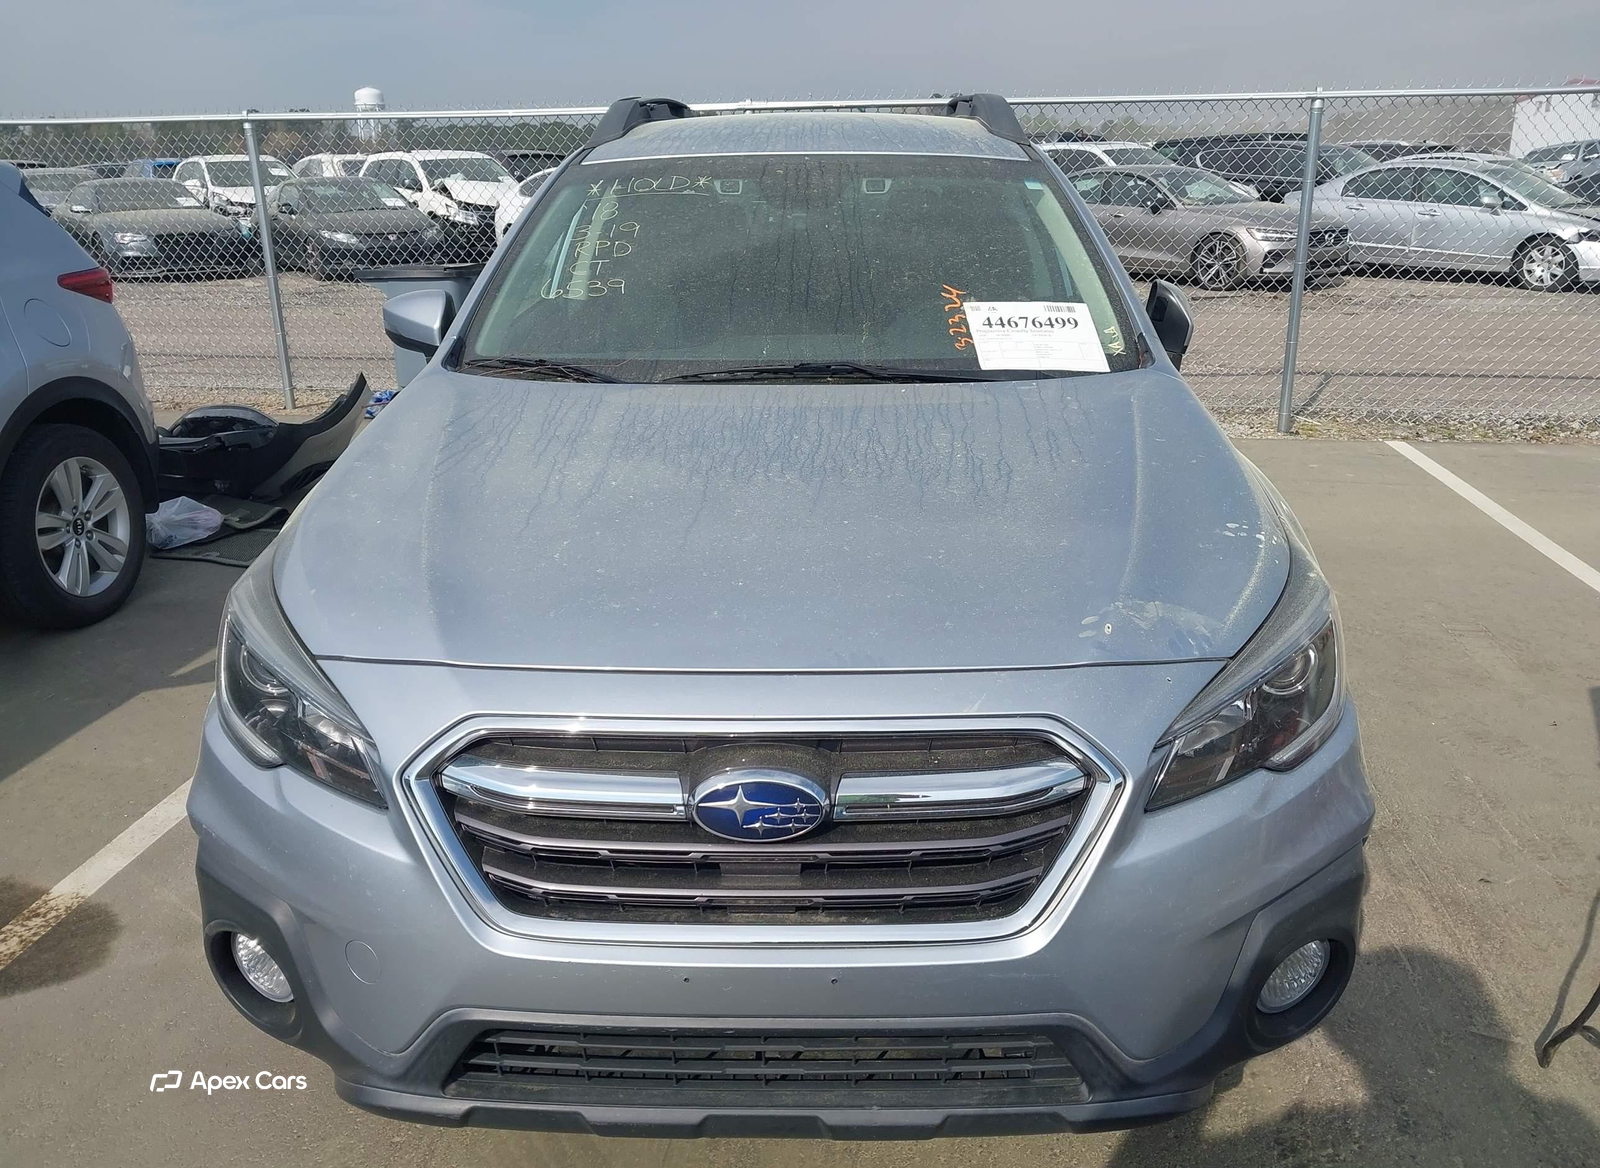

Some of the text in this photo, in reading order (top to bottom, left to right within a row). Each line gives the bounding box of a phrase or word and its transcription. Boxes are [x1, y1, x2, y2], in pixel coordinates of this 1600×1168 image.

[574, 241, 632, 257] RPD
[540, 278, 625, 299] 6539
[981, 316, 1079, 329] 44676499
